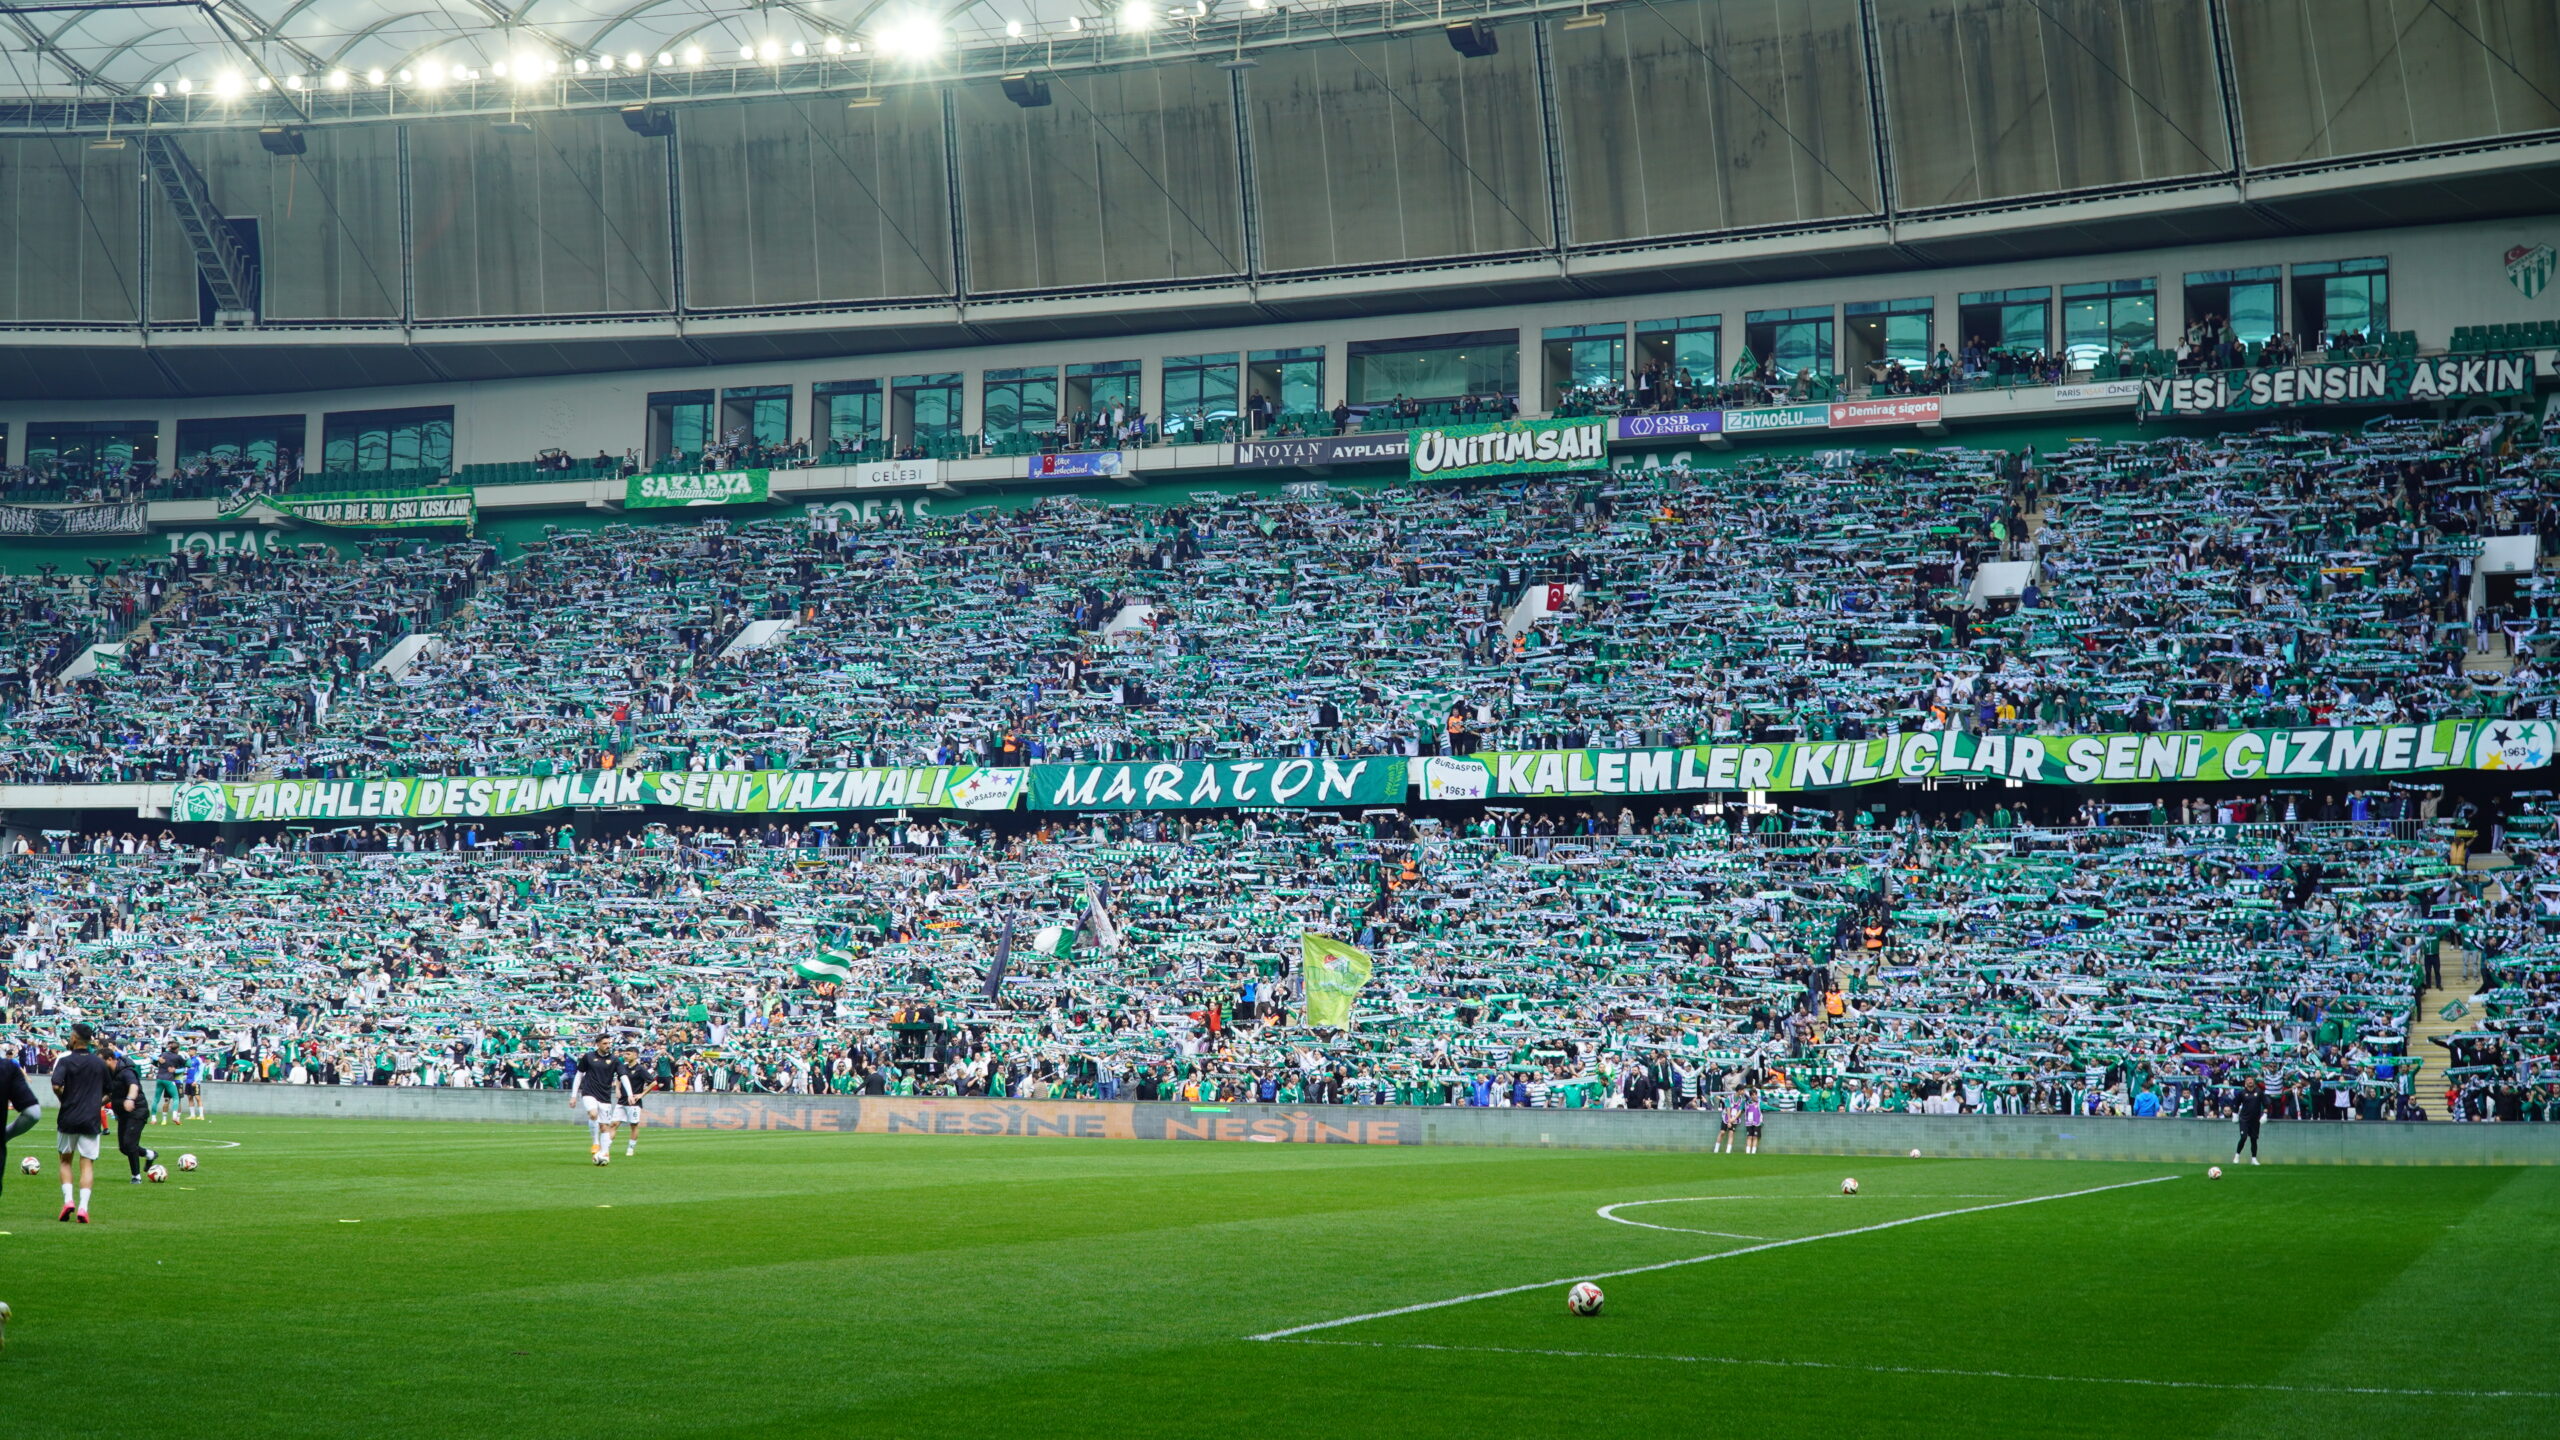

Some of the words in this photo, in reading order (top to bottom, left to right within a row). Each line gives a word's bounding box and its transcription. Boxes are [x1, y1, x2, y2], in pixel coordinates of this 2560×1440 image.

[2249, 363, 2386, 403] SENSİN
[2408, 358, 2525, 396] AŞKIN
[2057, 388, 2080, 397] PARİS
[1898, 402, 1938, 415] sigorta
[1656, 415, 1688, 425] OSB
[1742, 409, 1803, 428] ZİYAOĞLU
[1656, 423, 1709, 434] ENERGY
[1254, 442, 1319, 458] NOYAN
[641, 472, 752, 497] SAKARYA
[371, 503, 387, 519] BU
[2504, 747, 2526, 757] 1963
[1434, 757, 1483, 772] BURSASPOR
[1499, 747, 1771, 796] KALEMLER
[1053, 761, 1366, 806] MARATON
[1445, 785, 1466, 797] 1963
[416, 769, 643, 817] DESTANLAR
[766, 767, 950, 811] YAZMALI
[965, 791, 1008, 808] BURSASPOR
